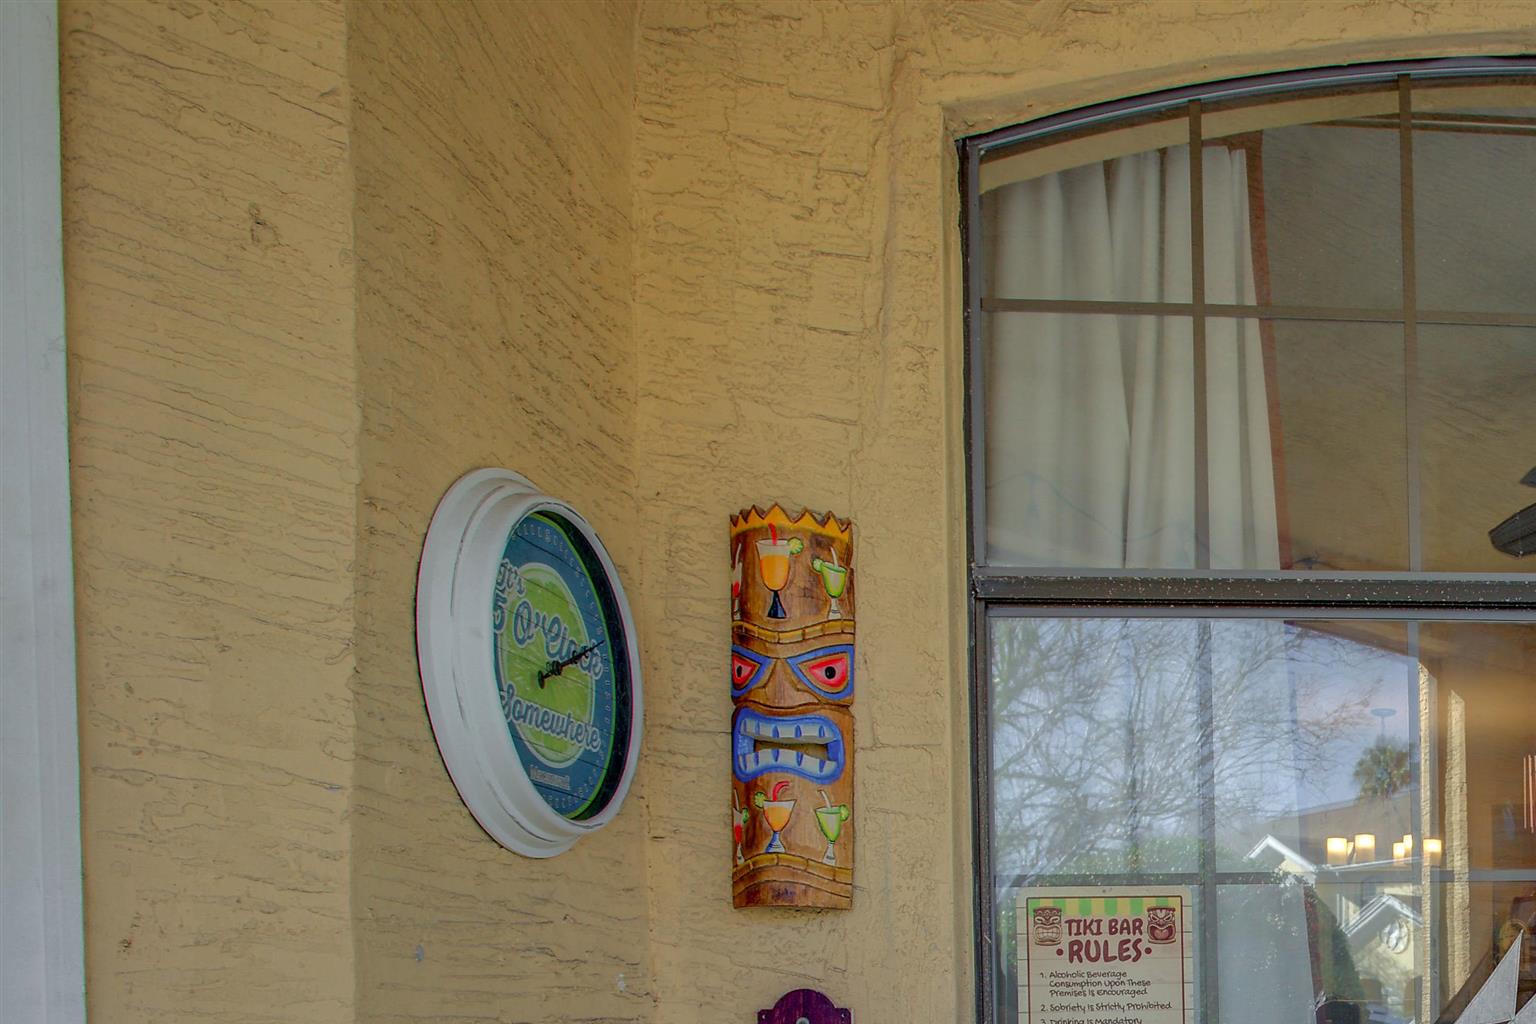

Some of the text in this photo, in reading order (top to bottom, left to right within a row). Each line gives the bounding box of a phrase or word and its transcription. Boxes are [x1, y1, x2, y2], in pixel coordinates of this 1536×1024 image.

[501, 681, 601, 752] Somewhere
[1064, 918, 1144, 936] TIKI BAR
[1068, 938, 1143, 964] RULES
[1049, 970, 1085, 979] Alcoholic
[1087, 971, 1128, 981] Beverage
[1049, 979, 1152, 990] Consumption Upon These
[1049, 989, 1087, 997] Premises
[1097, 988, 1148, 998] Encouraged
[1040, 1004, 1048, 1012] 2.
[1050, 1003, 1086, 1014] Sobriety
[1096, 1001, 1125, 1013] Strictly
[1126, 1001, 1172, 1010] Prohibited
